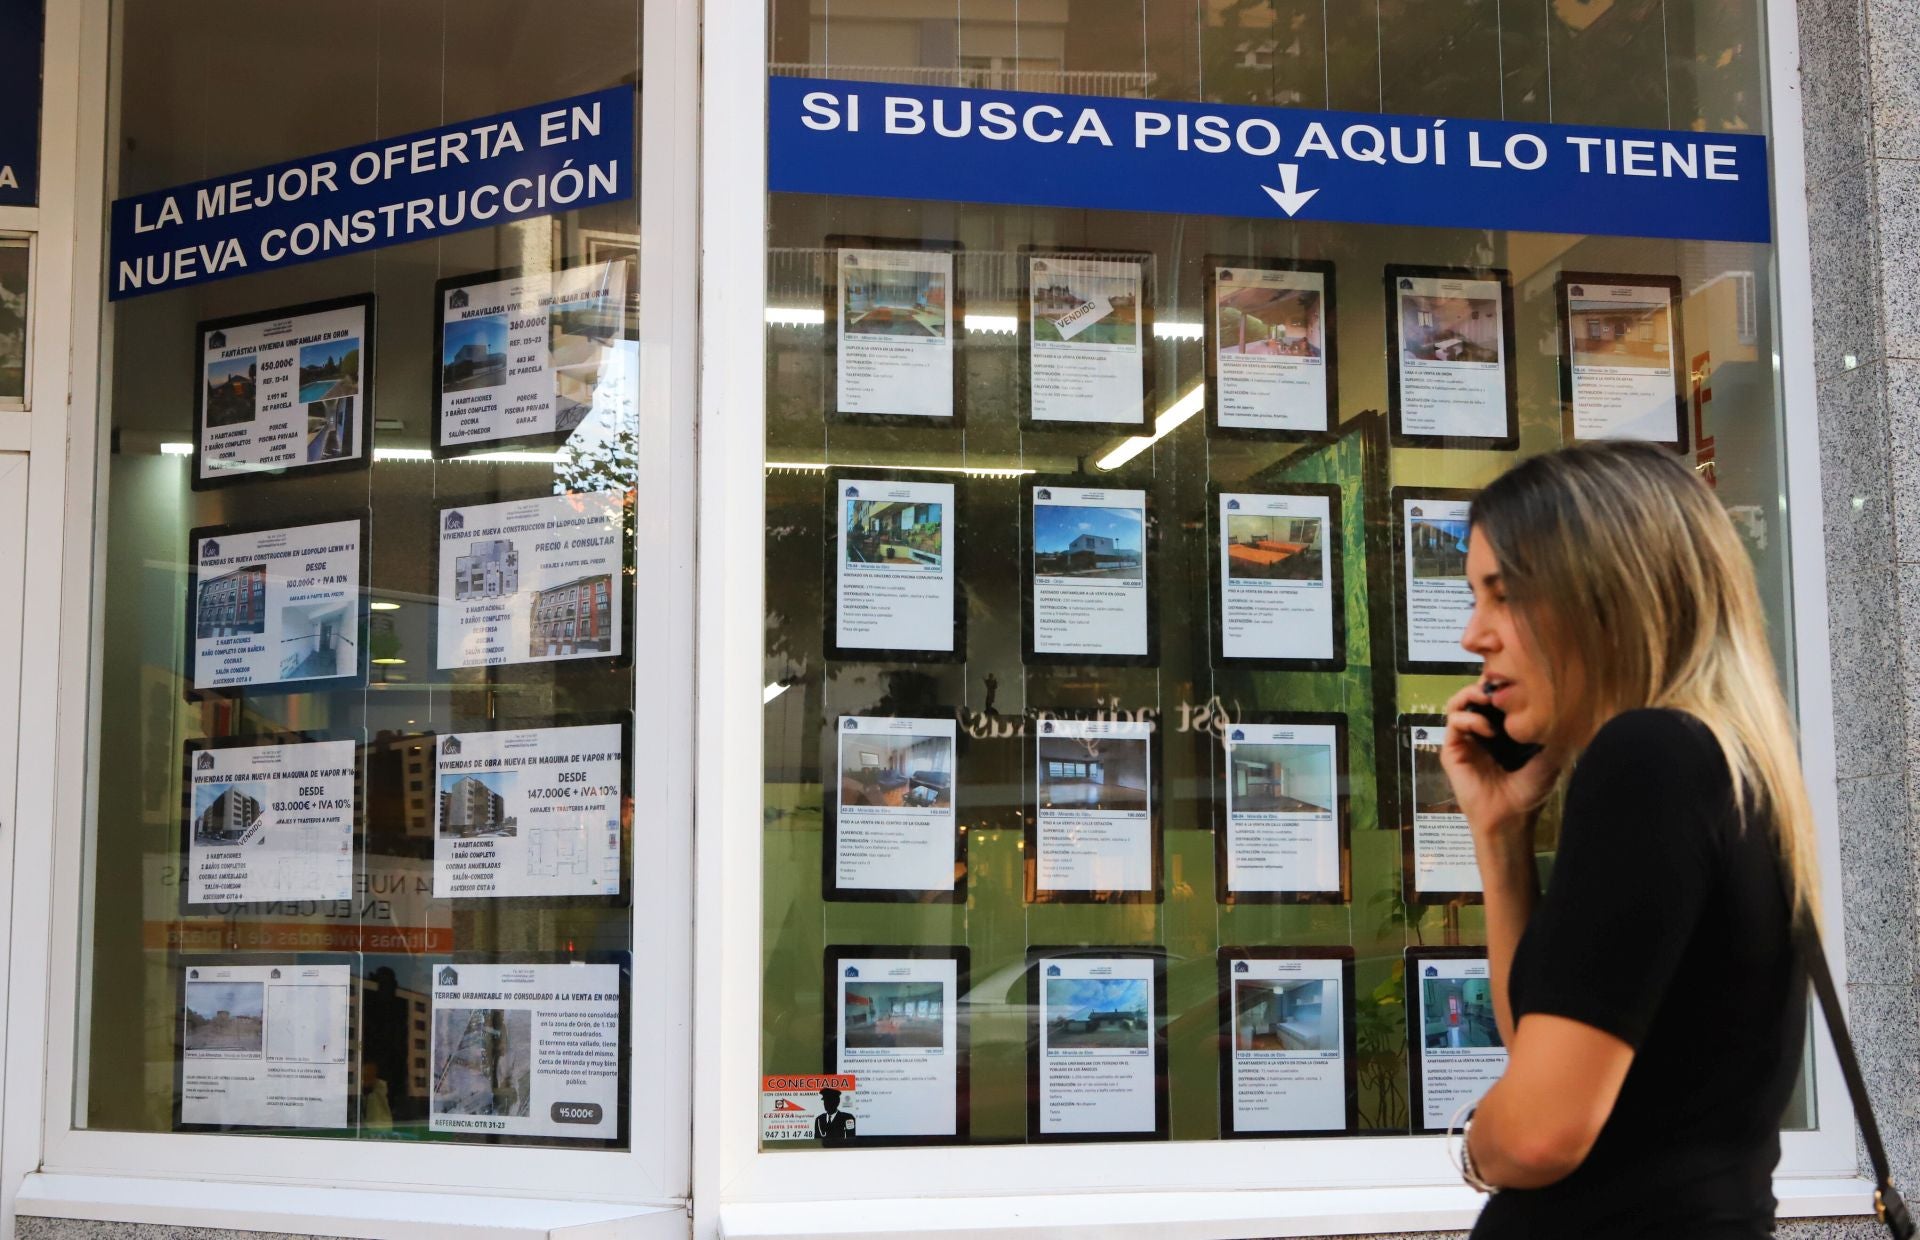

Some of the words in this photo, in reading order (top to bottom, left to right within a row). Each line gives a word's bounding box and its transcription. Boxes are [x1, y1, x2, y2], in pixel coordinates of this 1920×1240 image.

[801, 92, 859, 132] SI
[885, 96, 1113, 147] BUSCA
[1135, 111, 1281, 157] PISO
[1295, 119, 1447, 166] AQUÍ
[1469, 131, 1548, 170] LO
[1566, 136, 1739, 181] TIENE
[135, 197, 183, 235] LA
[195, 162, 337, 221] MEJOR
[350, 122, 518, 186] OFERTA
[540, 102, 601, 148] EN
[119, 238, 248, 292] NUEVA
[260, 159, 618, 264] CONSTRUCCIÓN
[461, 305, 505, 319] MARAVILLOSA
[1057, 301, 1096, 329] VENDIDO
[510, 316, 546, 331] 360.000€
[221, 345, 256, 358] FANTÁSTICA
[258, 341, 285, 352] VIVIENDA
[286, 334, 322, 347] UNIFAMILIAR
[323, 333, 331, 341] EN
[509, 338, 521, 347] REF.
[261, 358, 294, 371] 450.000€
[509, 368, 515, 376] DE
[517, 365, 542, 375] PARCELA
[262, 404, 268, 412] DE
[270, 402, 291, 411] PARCELA
[467, 404, 497, 414] COMPLETOS
[526, 403, 549, 413] PRIVADA
[442, 529, 471, 540] VIVIENDAS
[473, 529, 480, 537] DE
[482, 526, 501, 536] NUEVA
[547, 521, 555, 529] EN
[535, 541, 561, 552] PRECIO
[571, 536, 615, 549] CONSULTAR
[200, 558, 226, 567] VIVIENDAS
[236, 555, 252, 563] NUEVA
[306, 562, 326, 571] DESDE
[322, 576, 334, 585] IVA
[439, 760, 472, 769] VIVIENDAS
[474, 759, 482, 767] DE
[484, 758, 502, 767] OBRA
[504, 757, 526, 766] NUEVA
[528, 757, 537, 765] EN
[539, 755, 569, 764] MAQUINA
[571, 755, 580, 763] DE
[582, 754, 605, 762] VAPOR
[194, 775, 223, 783] VIVIENDAS
[225, 774, 233, 782] DE
[234, 773, 250, 781] OBRA
[320, 769, 340, 777] VAPOR
[558, 772, 587, 782] DESDE
[299, 786, 324, 795] DESDE
[528, 788, 571, 799] 147.000€
[581, 786, 597, 797] IVA
[599, 786, 618, 796] 10%
[318, 800, 332, 810] IVA
[335, 800, 351, 810] 10%
[239, 819, 263, 846] VENDIDO
[462, 992, 502, 1000] URBANIZABLE
[579, 1040, 601, 1048] vallado,
[588, 1070, 617, 1078] transporte
[768, 1078, 849, 1089] CONECTADA
[559, 1108, 594, 1119] 45.000€
[435, 1119, 473, 1128] REFERENCIA:
[474, 1120, 487, 1128] OTR
[489, 1121, 505, 1129] 31-23
